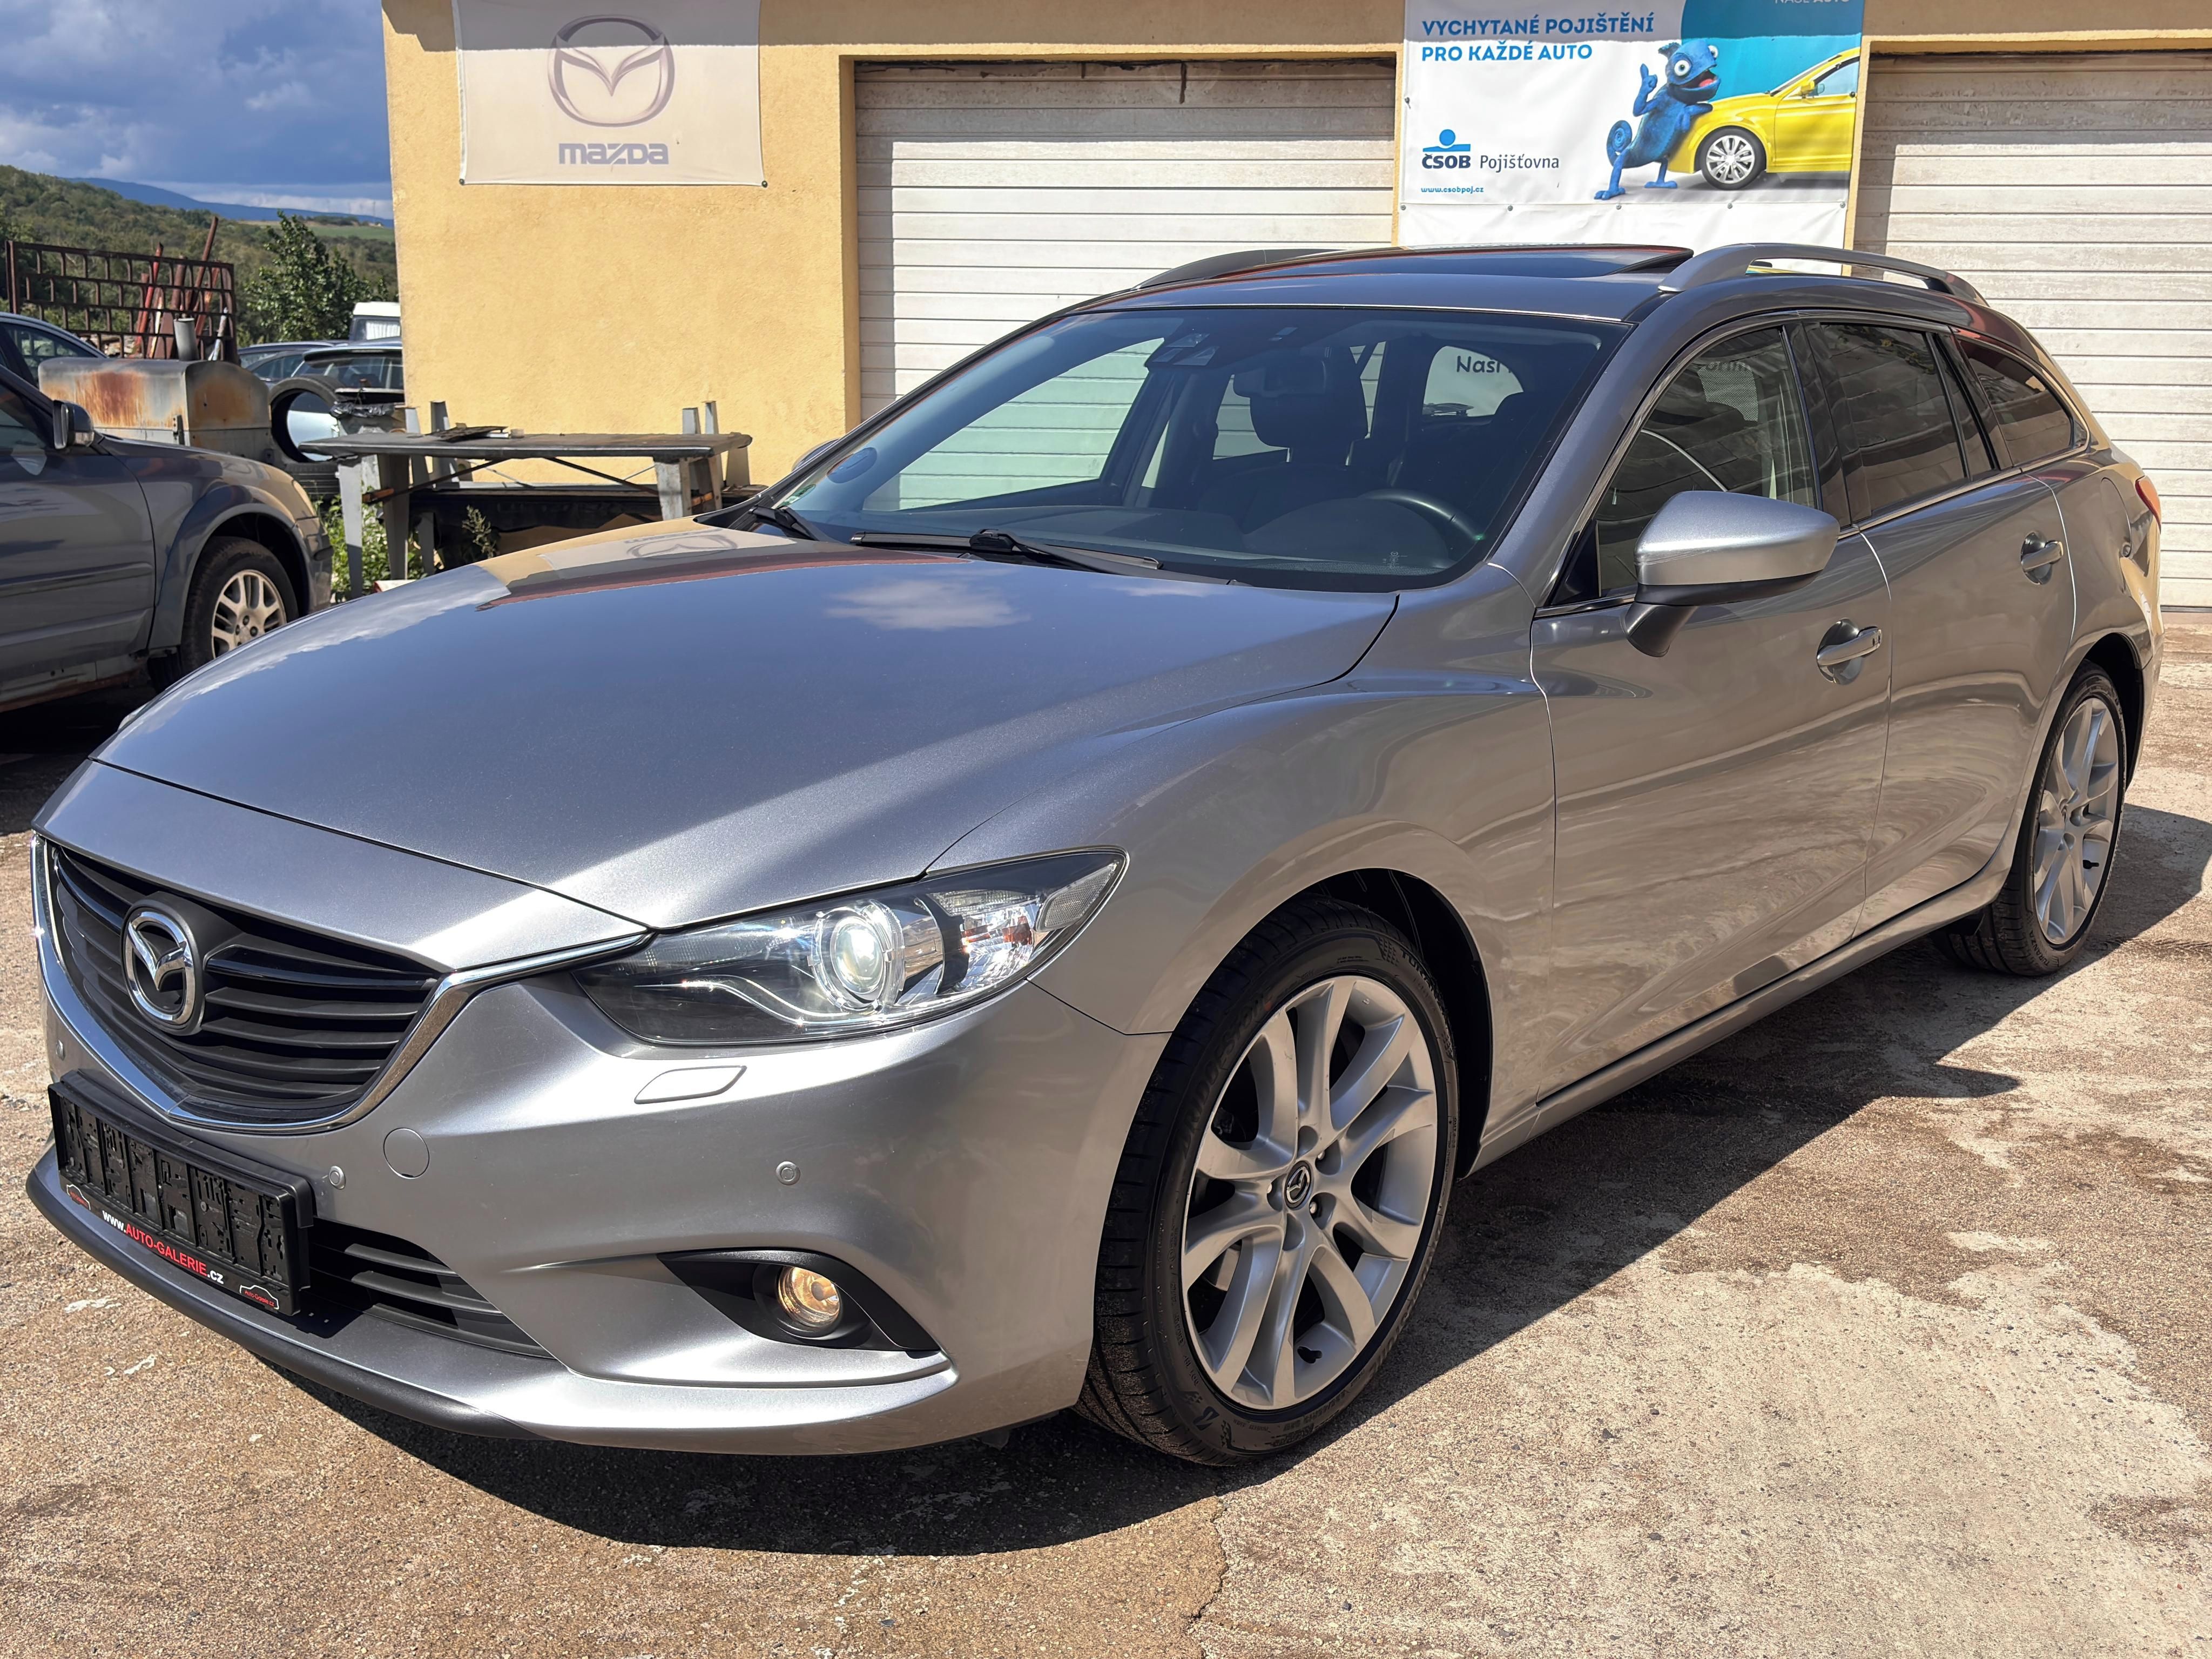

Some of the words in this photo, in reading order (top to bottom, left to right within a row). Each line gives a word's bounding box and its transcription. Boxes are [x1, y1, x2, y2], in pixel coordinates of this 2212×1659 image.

[1422, 14, 1539, 36] VYCHYTANÉ
[1546, 12, 1654, 34] POJIŠTĚNÍ
[1421, 46, 1463, 62] PRO
[1468, 40, 1533, 61] KAŽDÉ
[1537, 44, 1593, 60] AUTO
[1421, 153, 1471, 169] ČSOB
[1480, 154, 1560, 173] Pojišťovna
[1421, 186, 1484, 194] www.csobpoj.cz
[102, 1210, 224, 1285] www.AUTO-GALERIE.cz
